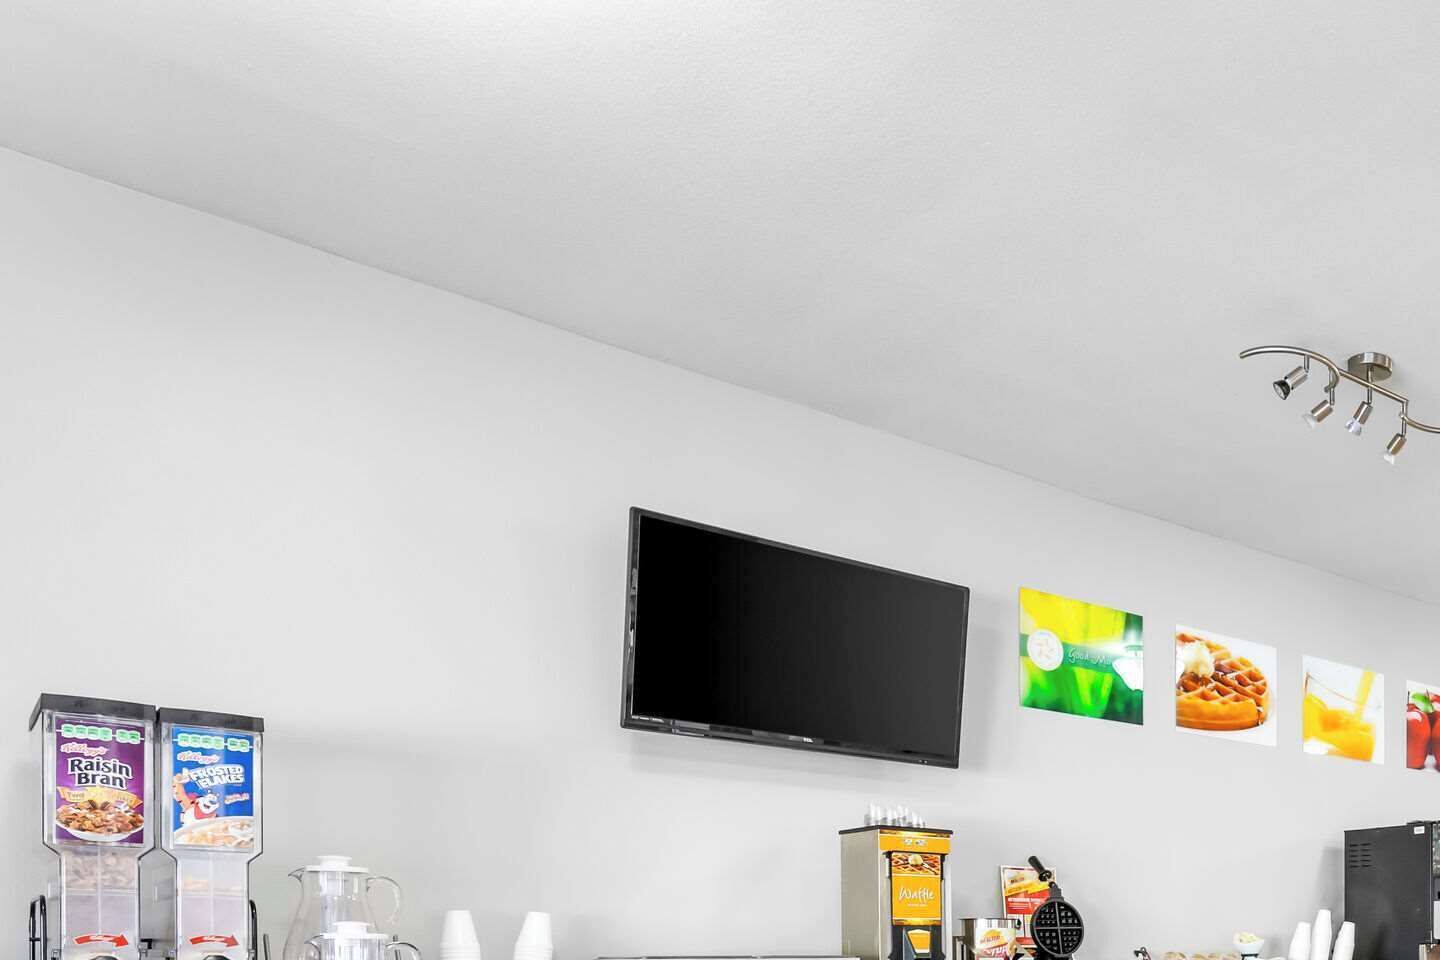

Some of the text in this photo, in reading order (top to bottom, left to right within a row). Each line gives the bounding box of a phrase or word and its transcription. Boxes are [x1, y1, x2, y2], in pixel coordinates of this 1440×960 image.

[69, 758, 132, 778] Raisin
[77, 772, 125, 789] Bran
[899, 886, 935, 902] Waffle
